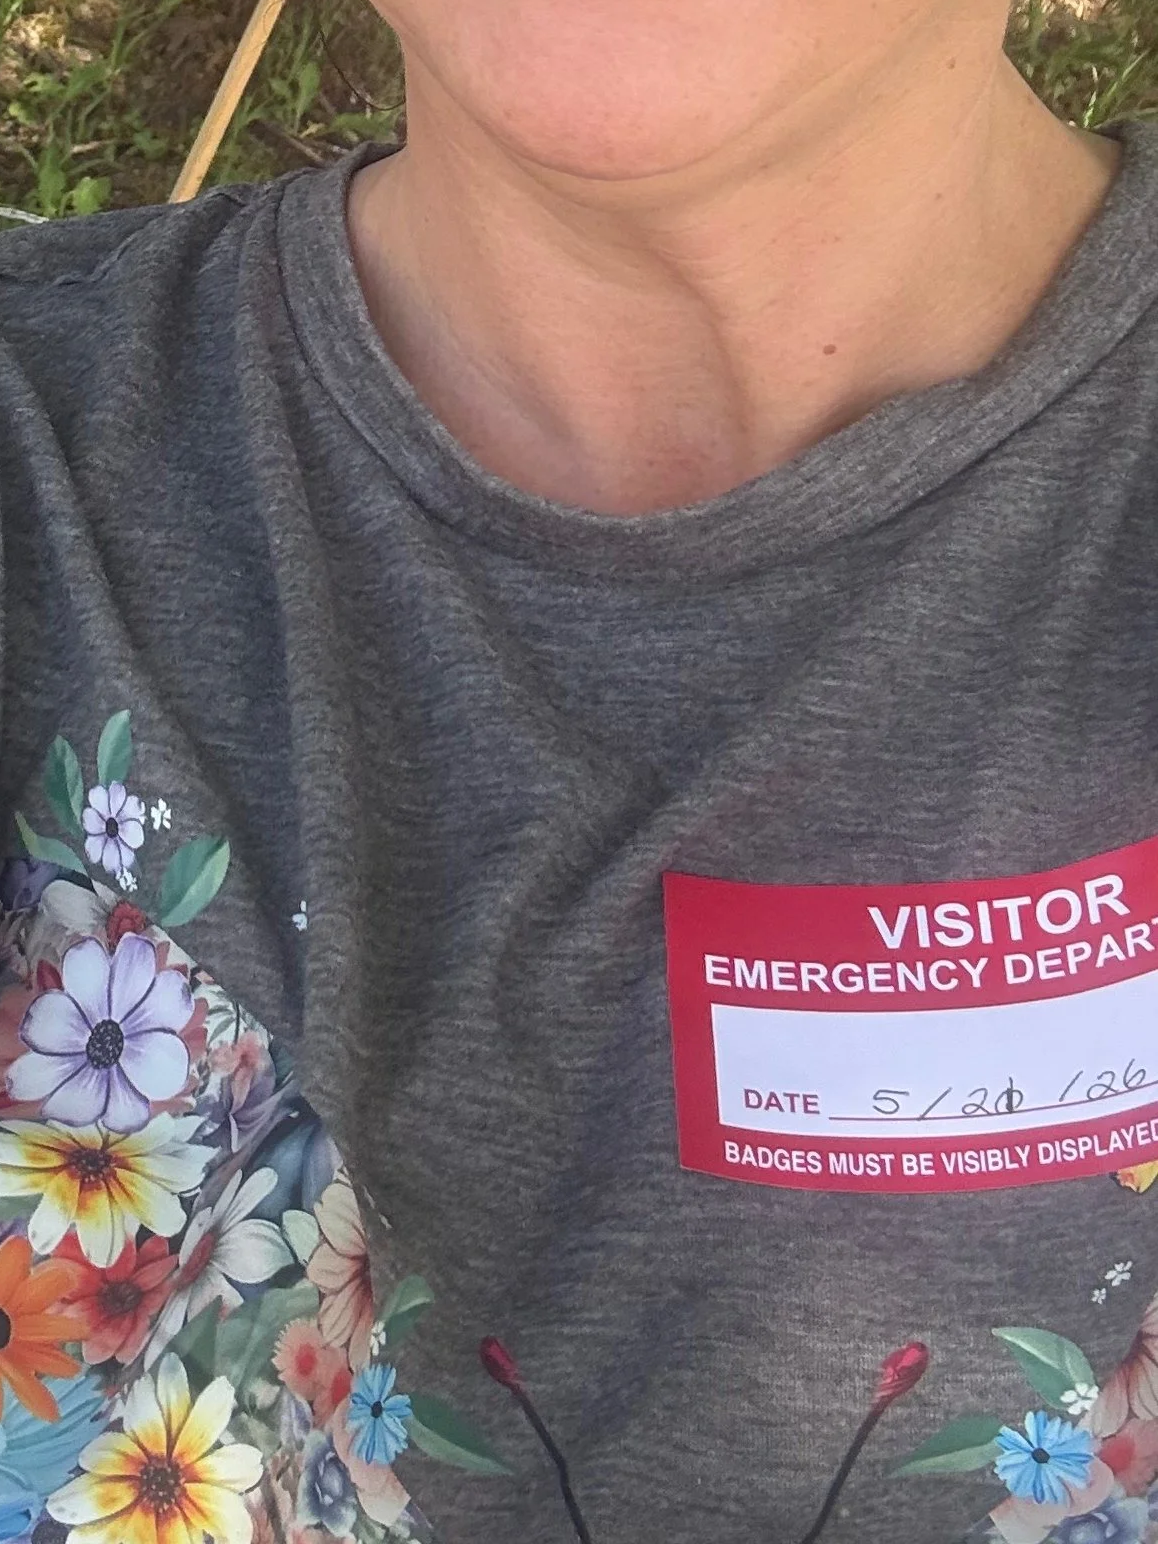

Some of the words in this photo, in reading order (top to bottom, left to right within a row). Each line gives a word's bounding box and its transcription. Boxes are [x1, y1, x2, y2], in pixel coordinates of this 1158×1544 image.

[867, 874, 1131, 949] VISITOR
[704, 953, 989, 994] EMERGENCY
[1003, 916, 1158, 985] DEPAR
[743, 1088, 821, 1115] DATE
[724, 1140, 822, 1174] BADGES
[829, 1151, 896, 1176] MUST
[902, 1152, 936, 1176] BE
[941, 1144, 1031, 1176] VISIBLY
